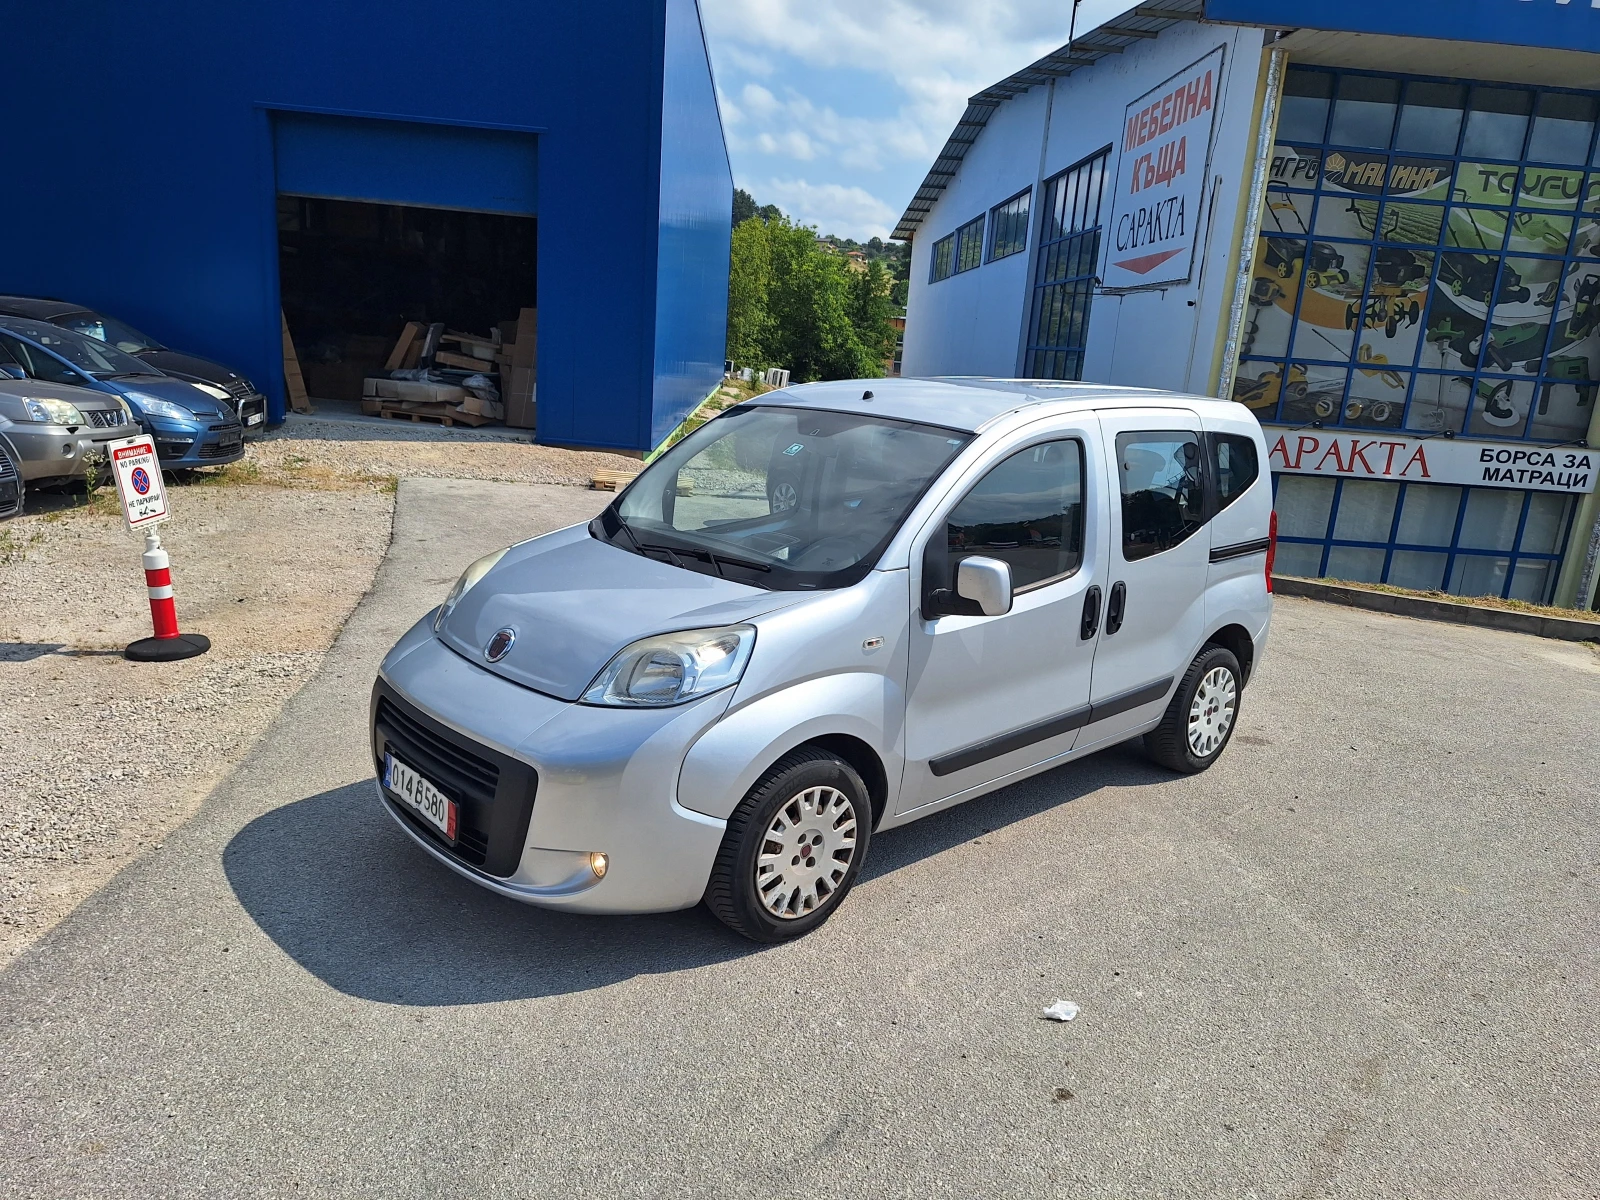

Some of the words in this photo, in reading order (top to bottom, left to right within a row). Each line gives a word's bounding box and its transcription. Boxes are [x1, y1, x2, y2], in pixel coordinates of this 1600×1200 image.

[1124, 69, 1212, 153] МЕБЕЛНА
[1130, 135, 1187, 195] КЪЩА
[1269, 156, 1320, 181] АГРО
[1342, 160, 1440, 190] МАШИНИ
[1116, 193, 1186, 252] САРАКТА
[120, 461, 128, 469] NO
[1268, 434, 1430, 477] АРАКТА
[1479, 448, 1556, 467] БОРСА
[1563, 453, 1592, 470] ЗА
[1482, 467, 1588, 489] МАТРАЦИ
[128, 500, 136, 508] НЕ
